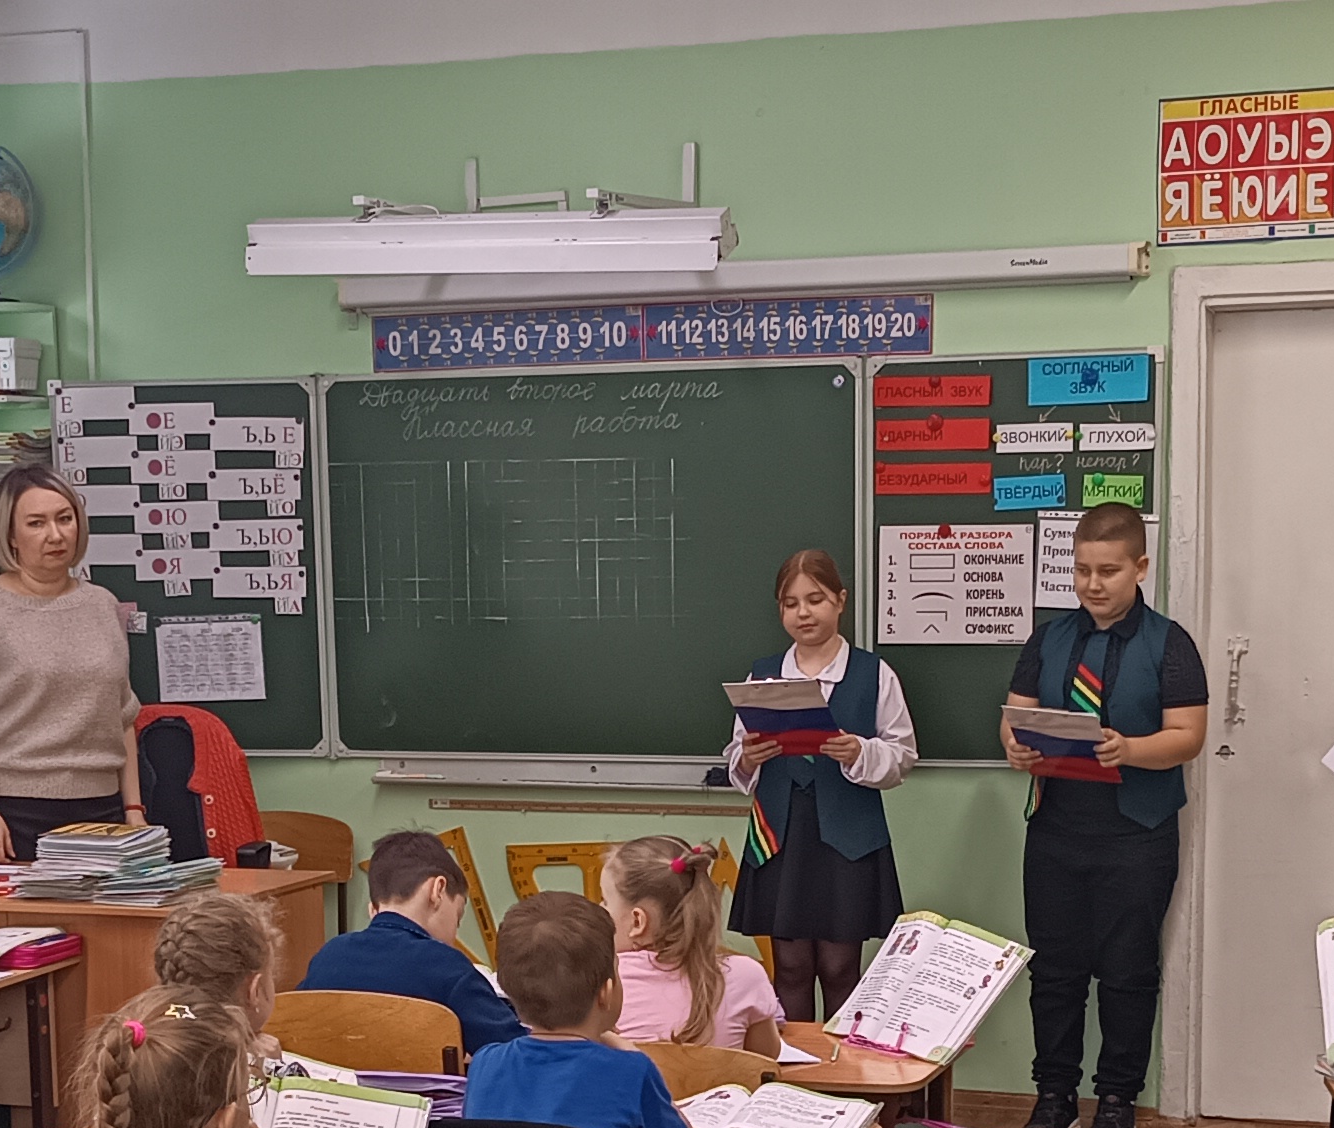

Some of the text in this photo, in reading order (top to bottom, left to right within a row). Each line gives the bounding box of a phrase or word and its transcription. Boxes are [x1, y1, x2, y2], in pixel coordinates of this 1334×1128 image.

[1199, 94, 1299, 116] ГЛАСНЫЕ
[658, 312, 916, 344] 11 12 13 14 15 16 17 18 19 20
[388, 321, 626, 356] 0 1 2 3 4 5 6 7 8 9 10
[1041, 360, 1134, 376] СОГЛАСНЫЙ
[877, 385, 984, 399] ГЛАСНЫЙ ЗВУК
[1069, 380, 1106, 395] ЗВУК
[359, 377, 723, 421] Двадцать второе марта
[403, 412, 536, 441] Классная
[878, 428, 943, 443] УДАРНЫЙ
[1000, 426, 1067, 444] ЗВОНКИЙ
[1088, 428, 1147, 444] ГЛУХОЙ
[878, 472, 968, 487] БЕЗУДАРНЫЙ
[1083, 482, 1143, 499] МЯГКИЙ
[899, 531, 1013, 540] ПОРЯДК РАЗБОРА
[908, 541, 1004, 550] СОСТАВА СЛОВА
[963, 554, 1025, 565] ОКОНЧАНИЕ
[963, 572, 1004, 582] ОСНОВА
[966, 589, 1005, 600] КОРЕНЬ
[965, 606, 1024, 617] ПРИСТАВКА
[965, 623, 1015, 635] СУФФИКС
